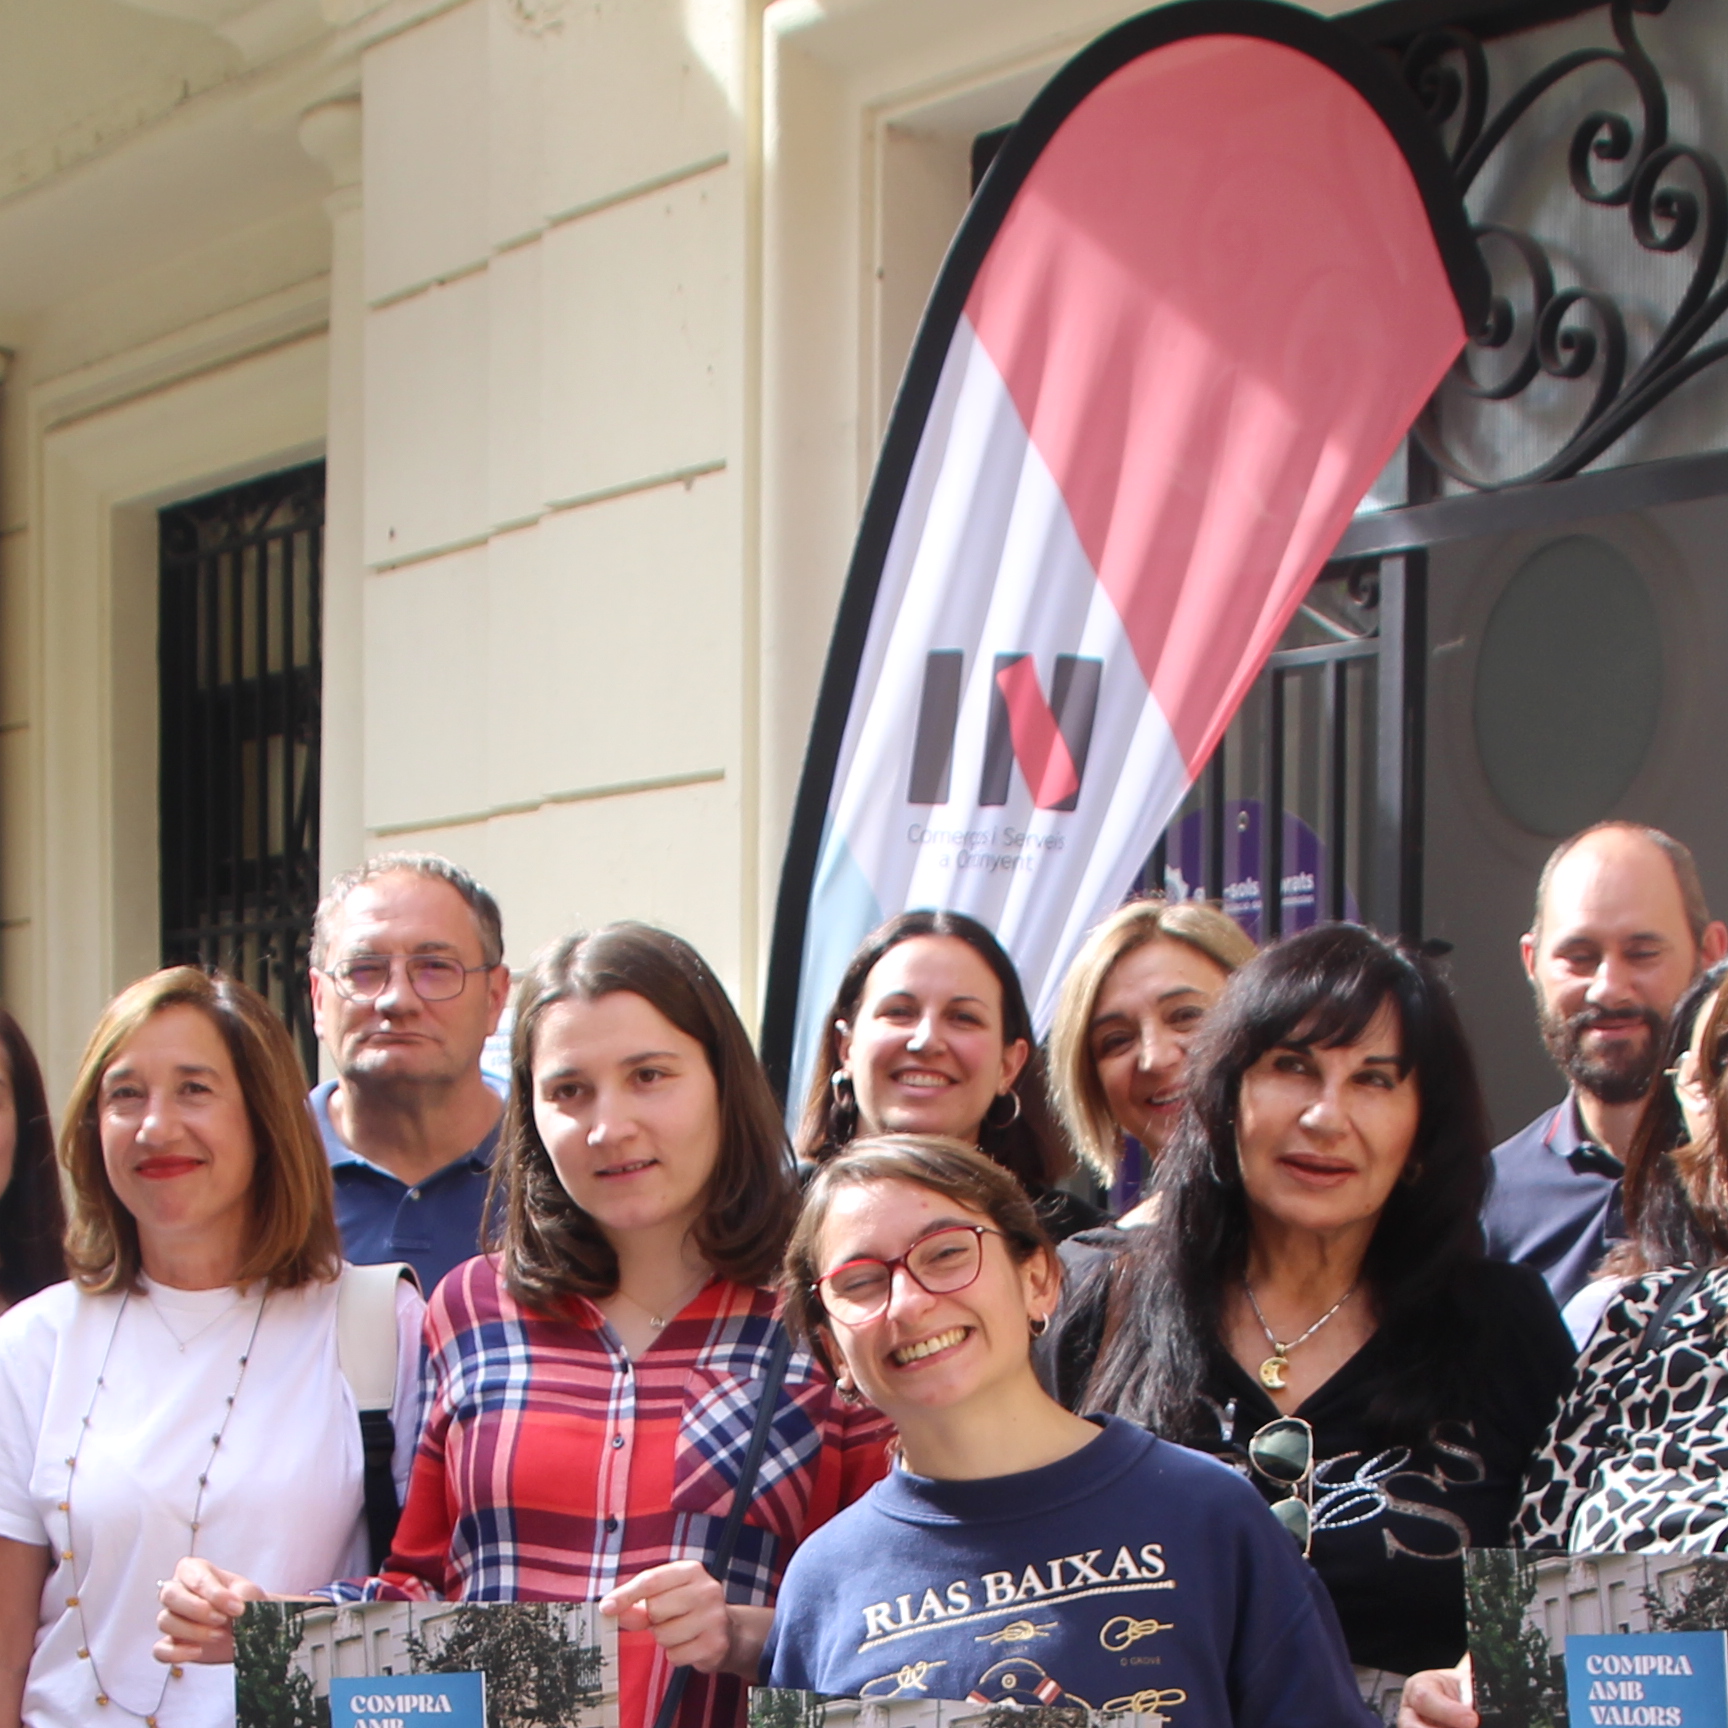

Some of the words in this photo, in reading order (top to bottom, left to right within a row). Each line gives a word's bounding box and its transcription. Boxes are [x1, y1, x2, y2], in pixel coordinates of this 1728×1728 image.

[862, 1580, 972, 1639] RIAS
[981, 1543, 1166, 1608] BAIXAS
[1586, 1653, 1694, 1676] COMPRA
[1588, 1680, 1646, 1701] AMB
[350, 1694, 452, 1714] COMPRA
[1589, 1705, 1683, 1727] VALORS
